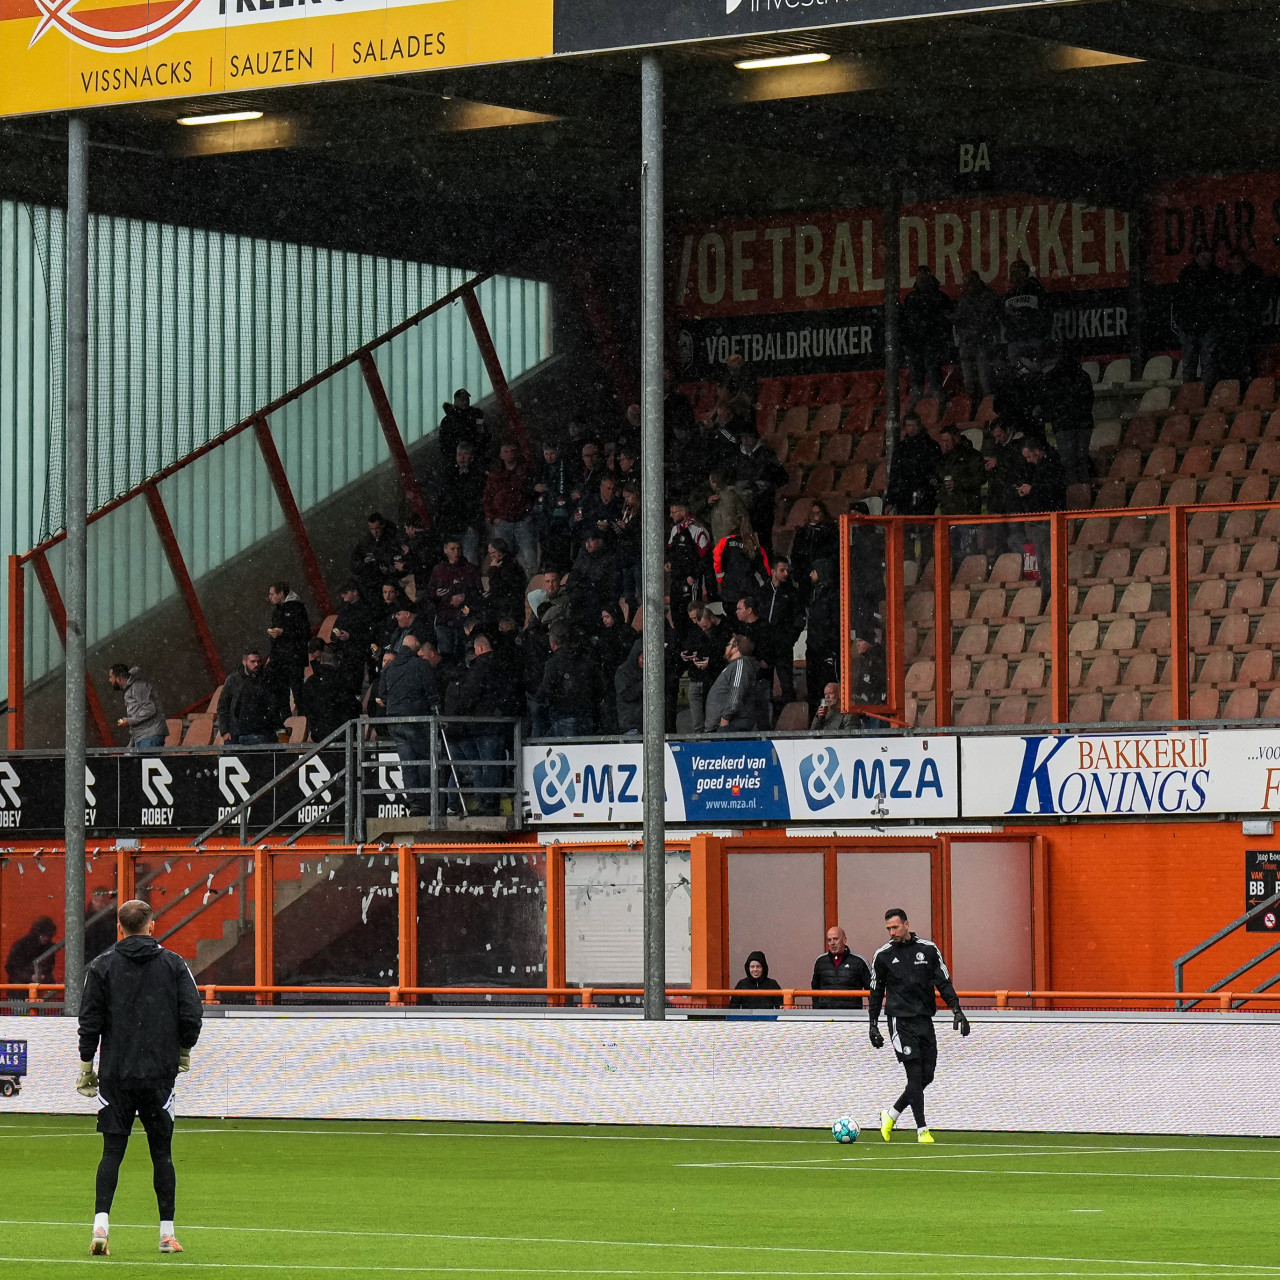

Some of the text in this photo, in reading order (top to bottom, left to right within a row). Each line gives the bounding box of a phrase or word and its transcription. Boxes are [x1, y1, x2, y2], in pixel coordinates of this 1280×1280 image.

[80, 32, 446, 94] VISSNACKS SAUZEN SALADES
[959, 141, 991, 175] BA
[691, 754, 766, 770] Verzekerd van
[1078, 738, 1210, 770] BAKKERIJ
[582, 764, 668, 804] MZ
[696, 774, 761, 794] goed advies
[851, 756, 944, 800] MZA
[705, 798, 757, 810] www.mza.nl
[140, 807, 174, 826] ROBEY
[1250, 871, 1264, 880] VAK
[1249, 880, 1265, 896] BB
[6, 1042, 26, 1053] EST
